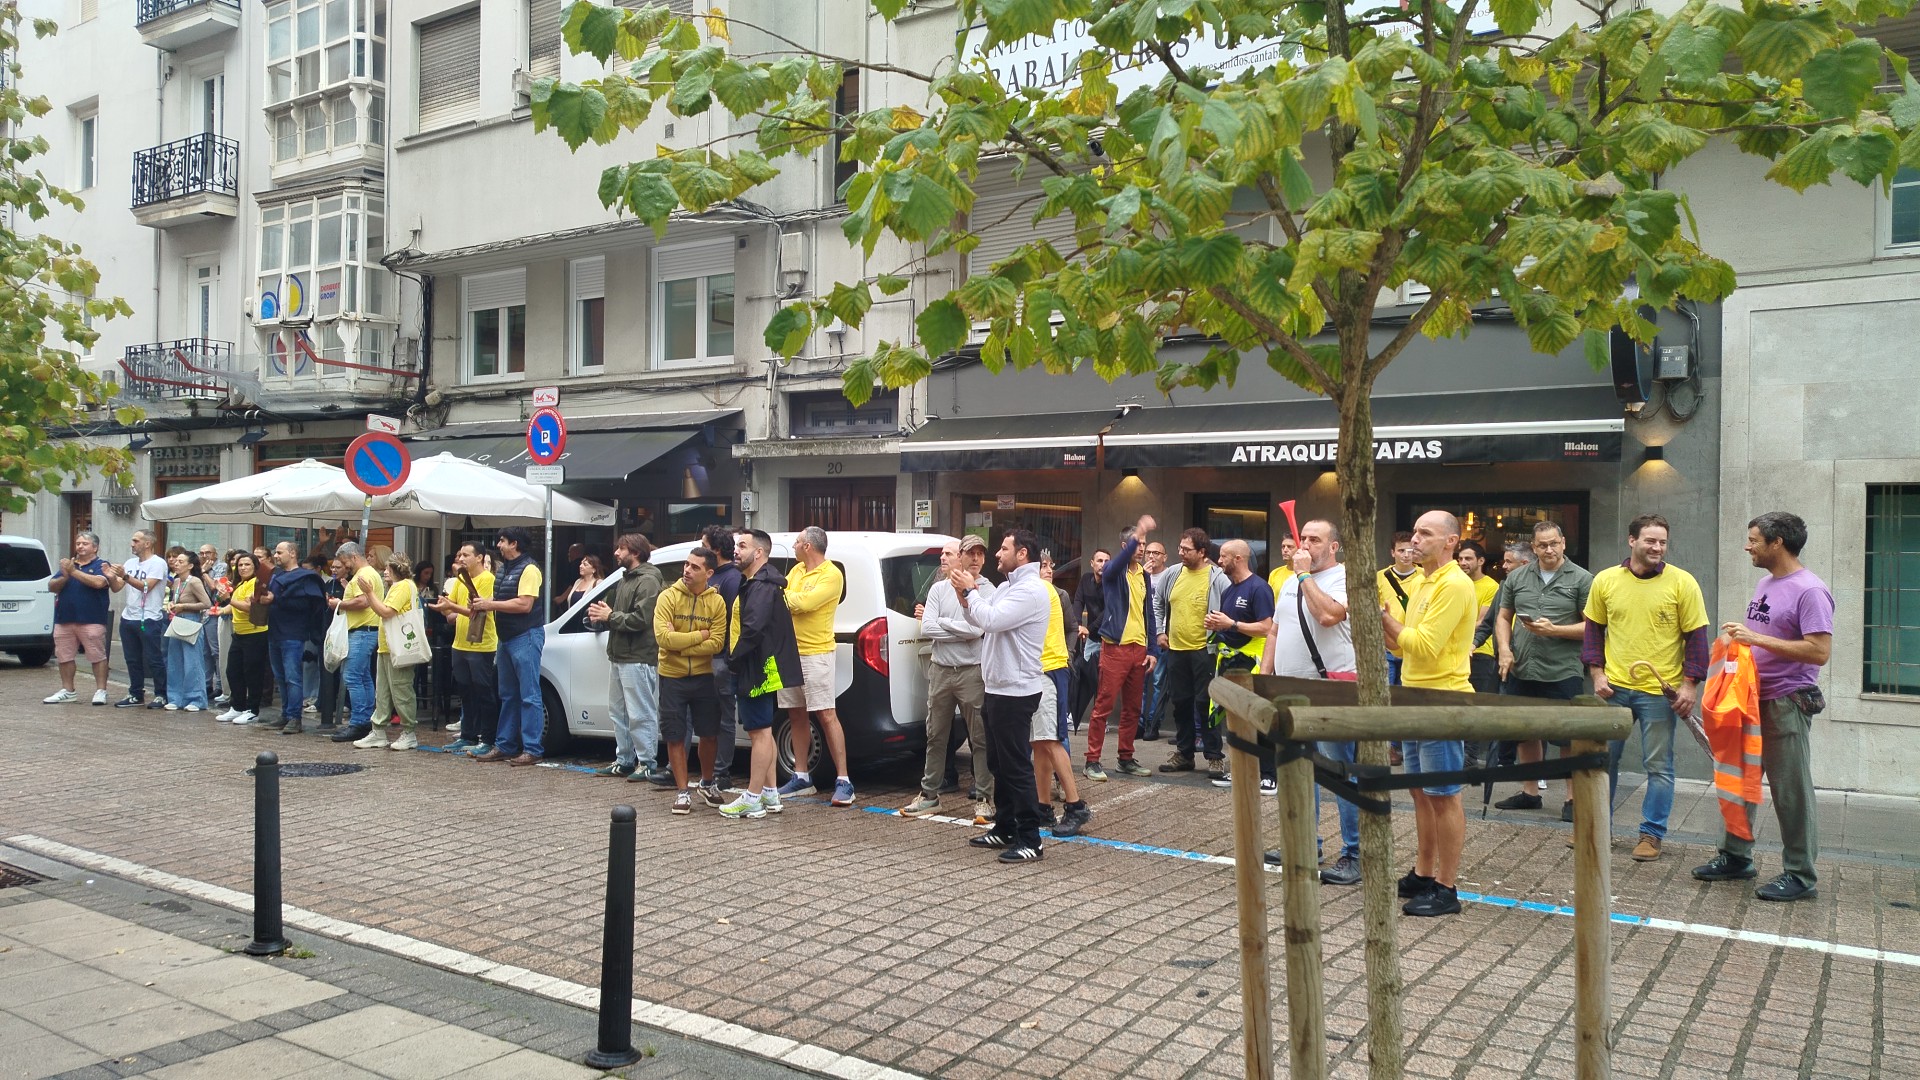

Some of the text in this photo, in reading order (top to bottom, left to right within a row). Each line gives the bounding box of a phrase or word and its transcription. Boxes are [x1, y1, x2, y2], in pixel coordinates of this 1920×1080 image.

[542, 432, 549, 442] P
[153, 446, 220, 459] BAR DEL
[1564, 442, 1599, 451] Mahou
[155, 463, 220, 476] PUERTO
[827, 461, 843, 475] 20
